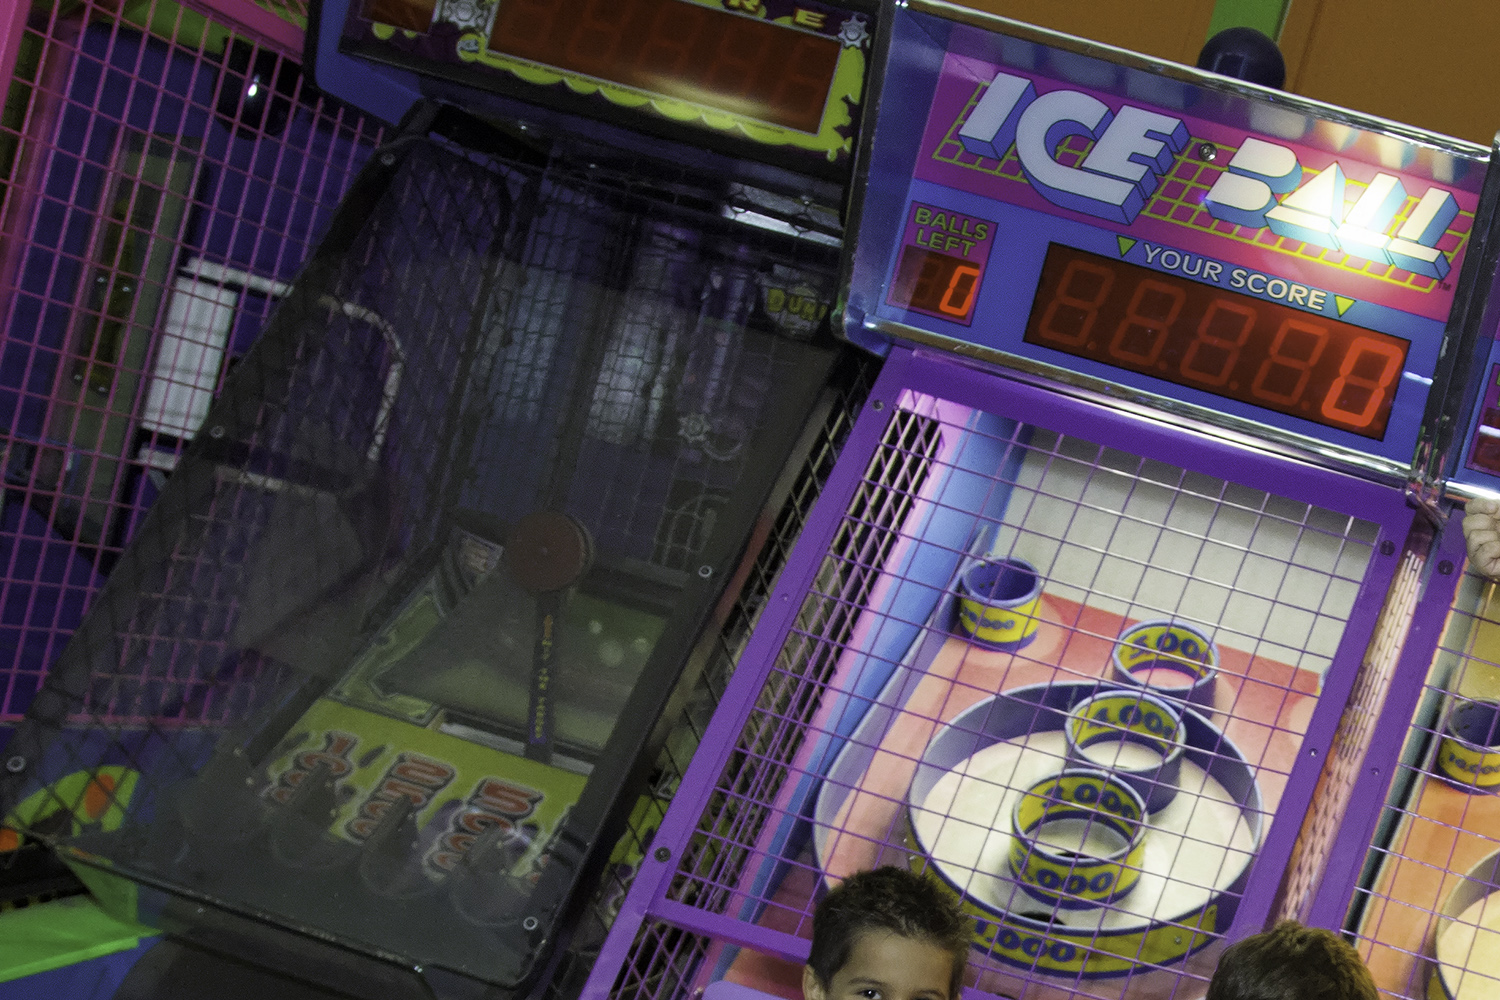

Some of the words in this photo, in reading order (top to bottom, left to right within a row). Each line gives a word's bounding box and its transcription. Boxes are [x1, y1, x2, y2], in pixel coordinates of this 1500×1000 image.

[957, 71, 1191, 225] ICE
[1204, 136, 1461, 281] BALL
[914, 206, 989, 240] BALLS
[915, 228, 977, 257] LEFT
[938, 265, 980, 316] 0
[1143, 243, 1223, 284] YOUR
[1230, 268, 1328, 312] SCORE
